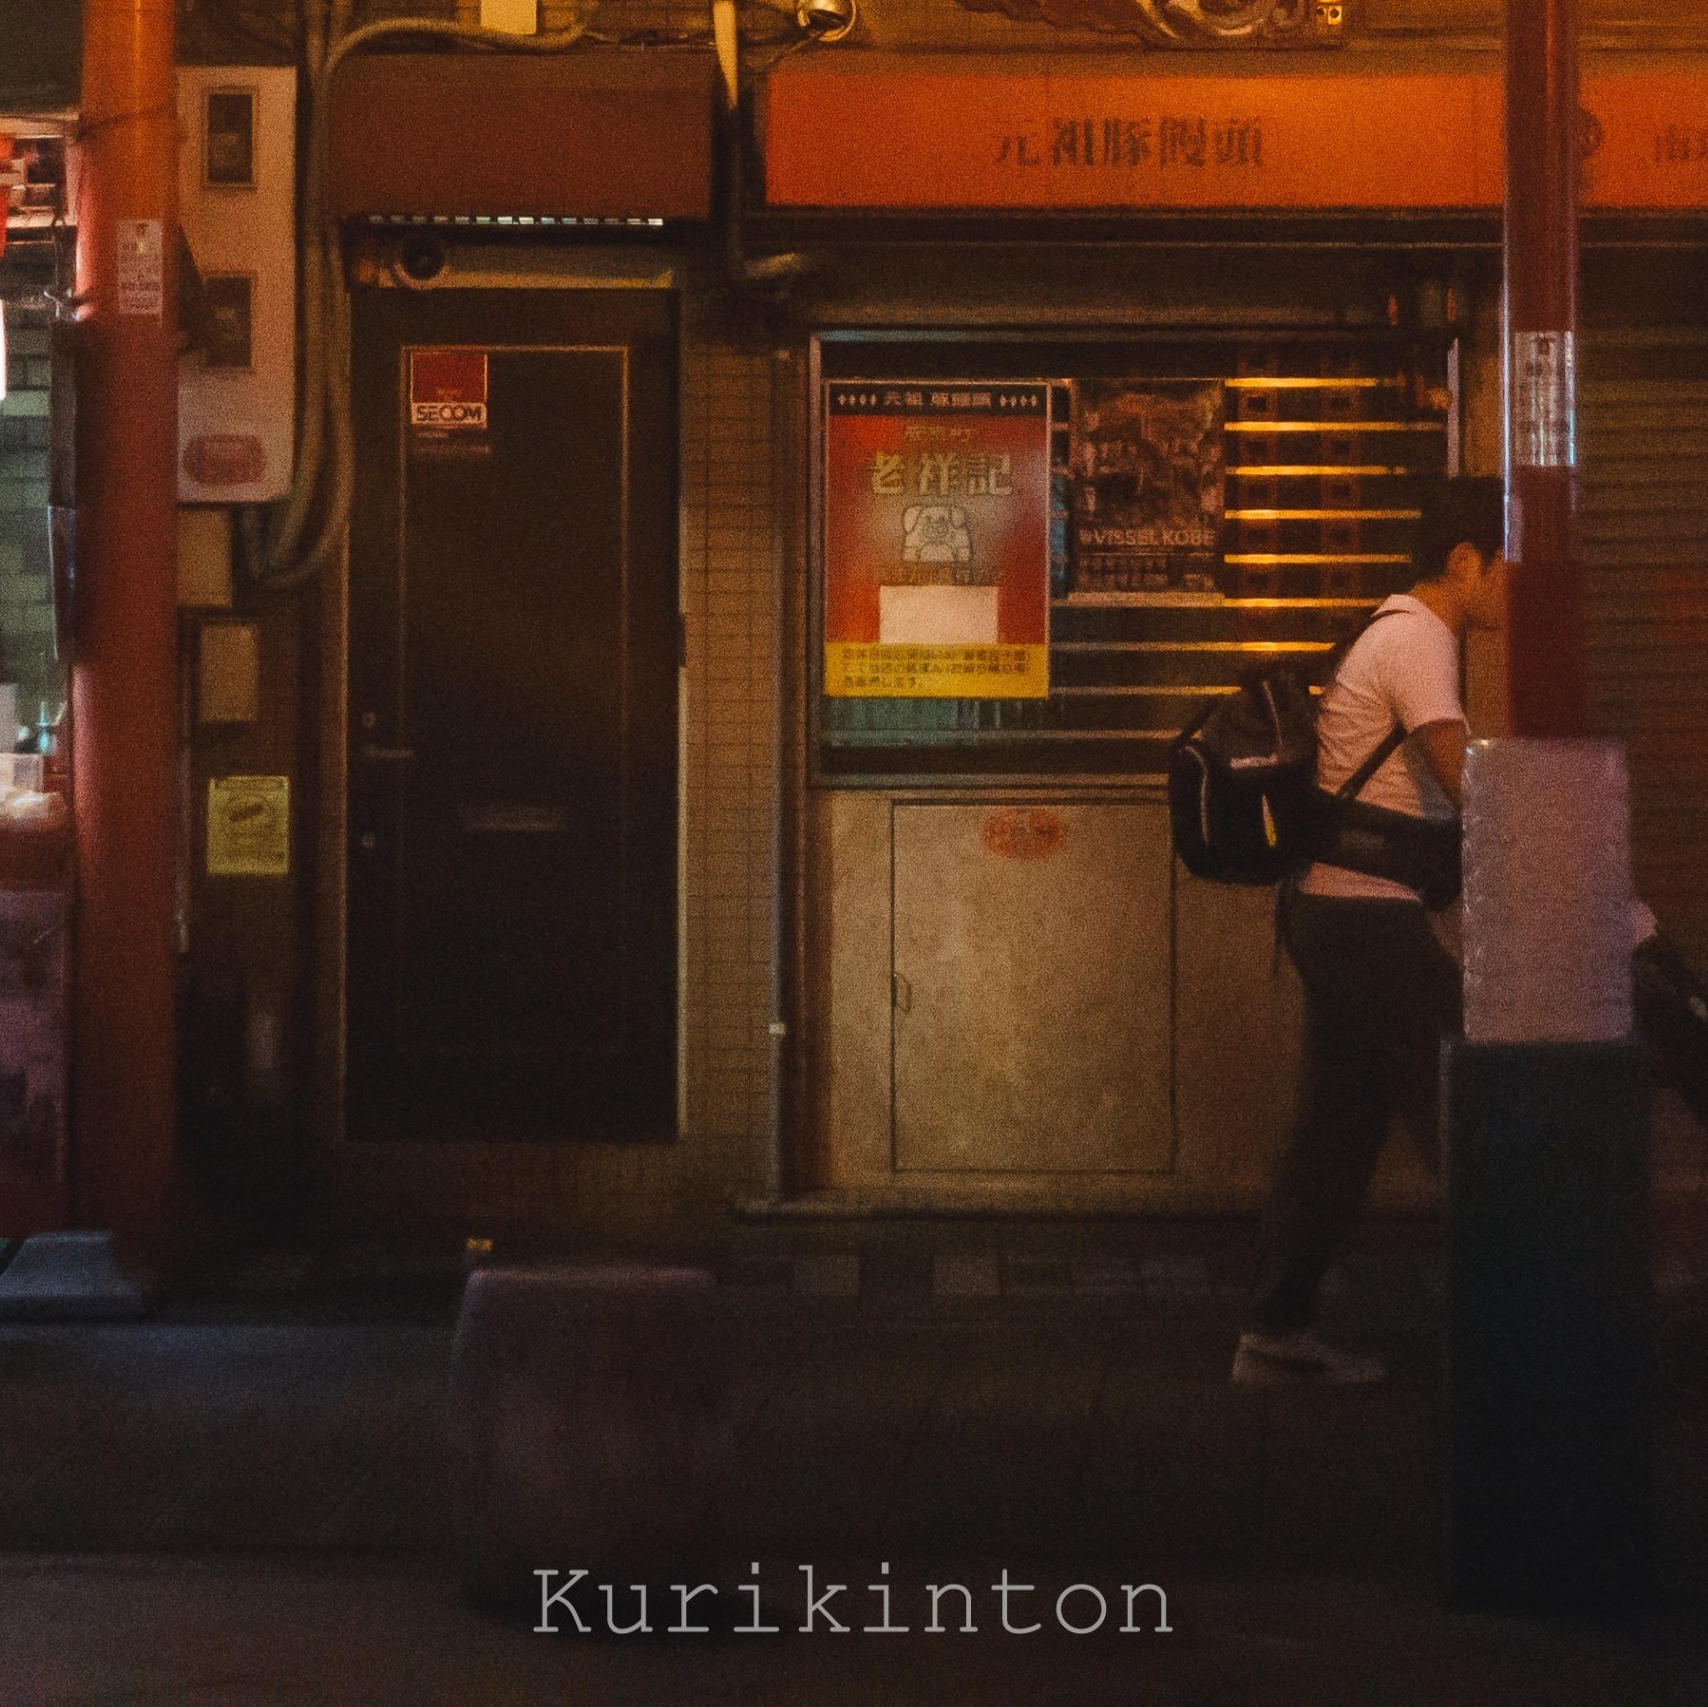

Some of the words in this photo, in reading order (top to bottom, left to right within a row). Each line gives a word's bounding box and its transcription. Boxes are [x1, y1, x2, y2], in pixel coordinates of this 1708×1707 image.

[415, 404, 483, 422] SECOM
[868, 451, 1014, 496] 老祥記
